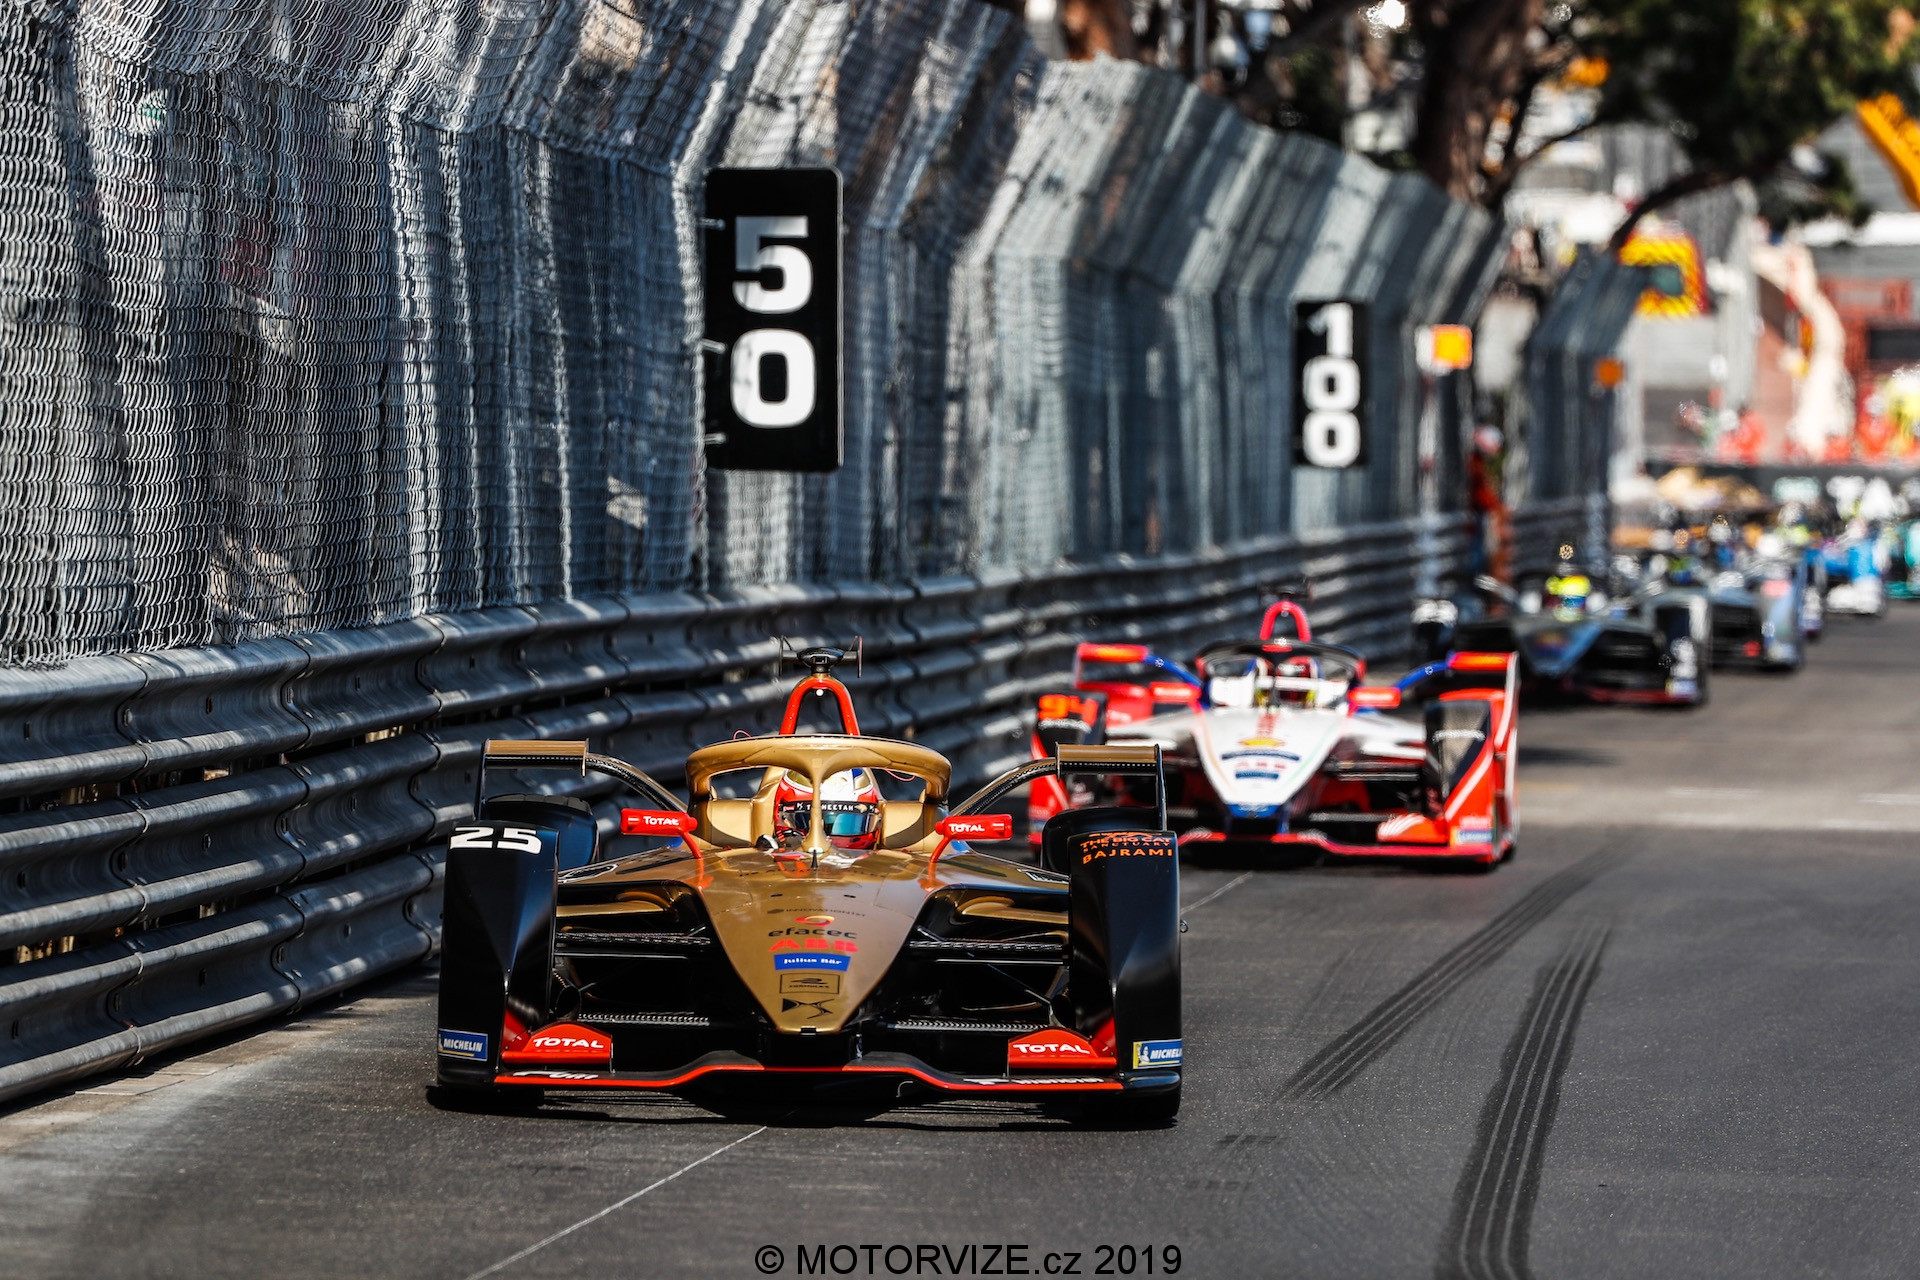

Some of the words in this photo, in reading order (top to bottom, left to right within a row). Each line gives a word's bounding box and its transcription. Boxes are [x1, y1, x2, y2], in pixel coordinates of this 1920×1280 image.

[731, 215, 817, 429] 50
[1307, 302, 1361, 468] 100
[643, 815, 679, 826] TOTAL
[948, 823, 985, 833] TOTAL
[450, 827, 541, 855] 25
[1080, 838, 1109, 848] THE
[1082, 848, 1173, 865] BAJRAMI
[768, 926, 857, 939] efacec
[767, 938, 859, 953] ABB
[783, 957, 817, 965] Julius
[443, 1037, 483, 1052] MICHELIN
[533, 1036, 604, 1049] TOTAL
[1012, 1043, 1090, 1054] TOTAL
